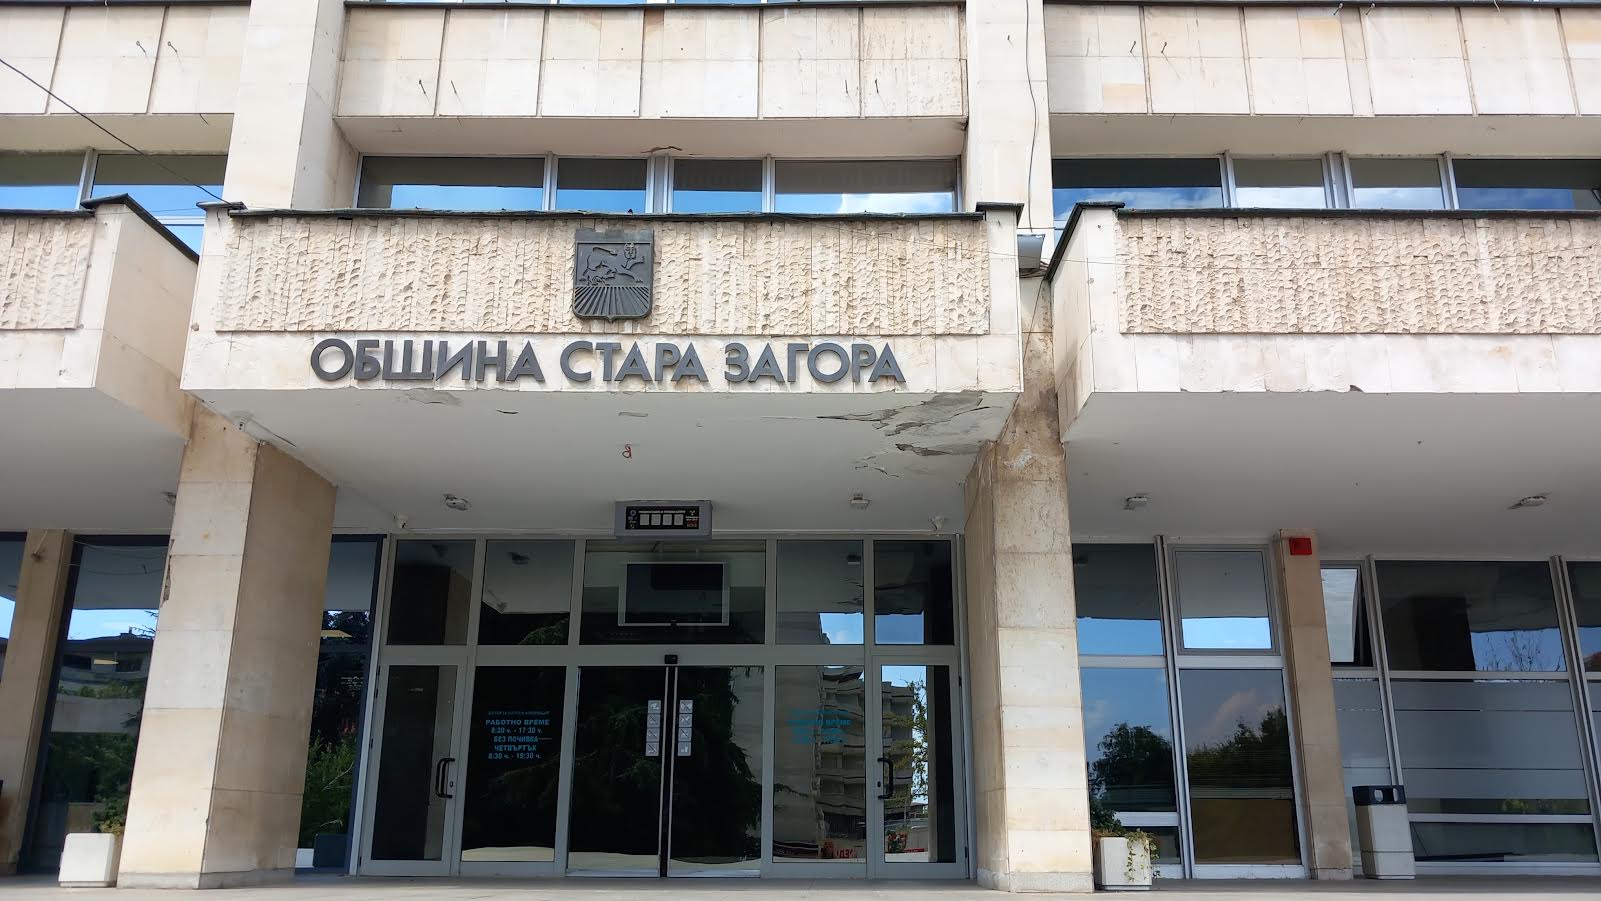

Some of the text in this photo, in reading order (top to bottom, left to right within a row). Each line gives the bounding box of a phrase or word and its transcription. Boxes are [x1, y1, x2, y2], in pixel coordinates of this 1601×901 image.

[310, 338, 907, 384] ОБЩИНА СТАРА ЗАГОРА
